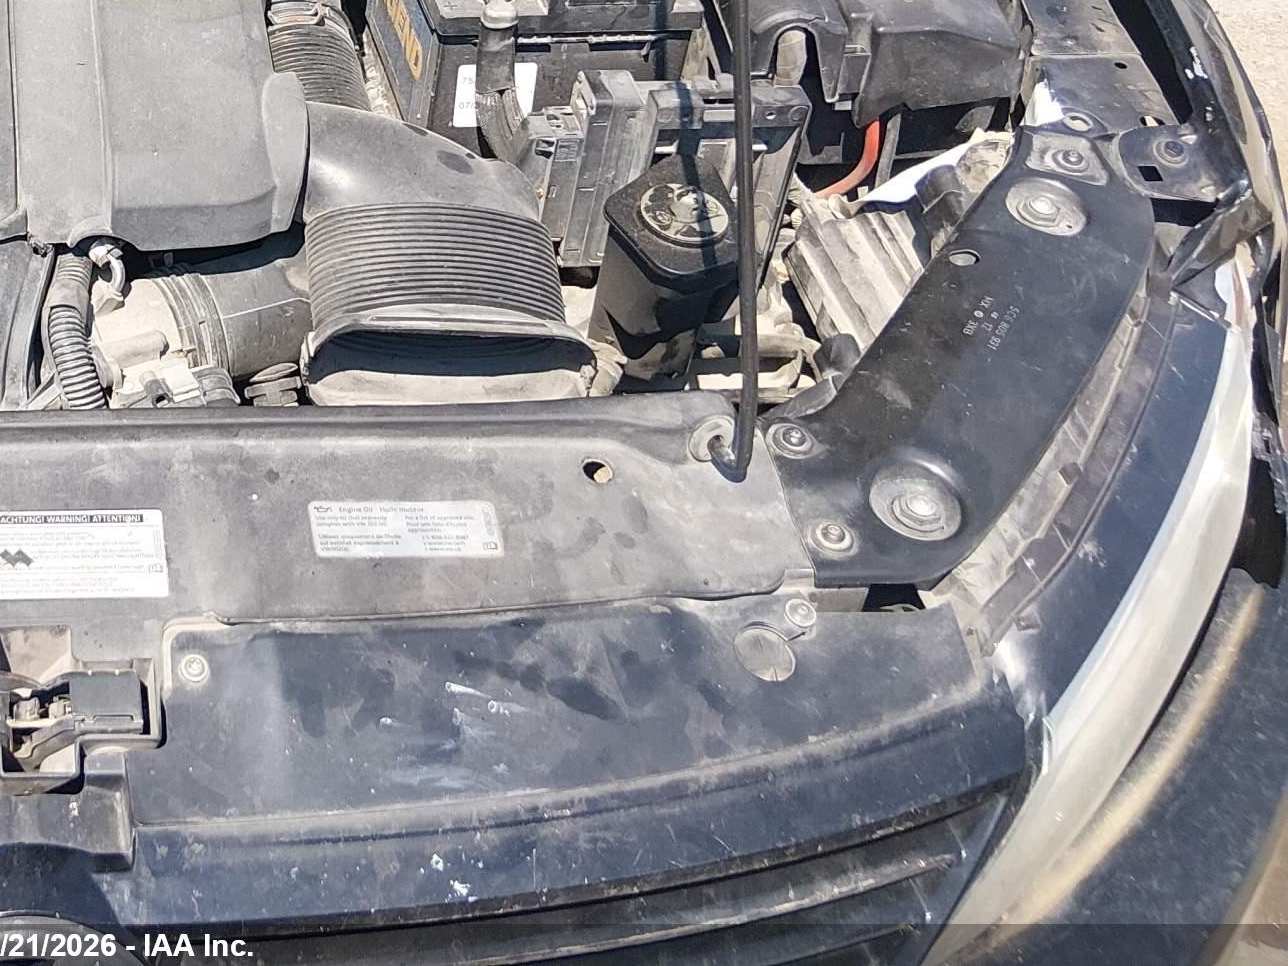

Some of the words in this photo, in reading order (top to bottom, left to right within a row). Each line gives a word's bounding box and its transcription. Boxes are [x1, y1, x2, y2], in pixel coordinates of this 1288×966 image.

[0, 515, 45, 524] ACHTUNG!
[46, 515, 91, 523] WARNING!
[92, 514, 141, 523] ATTENTION!
